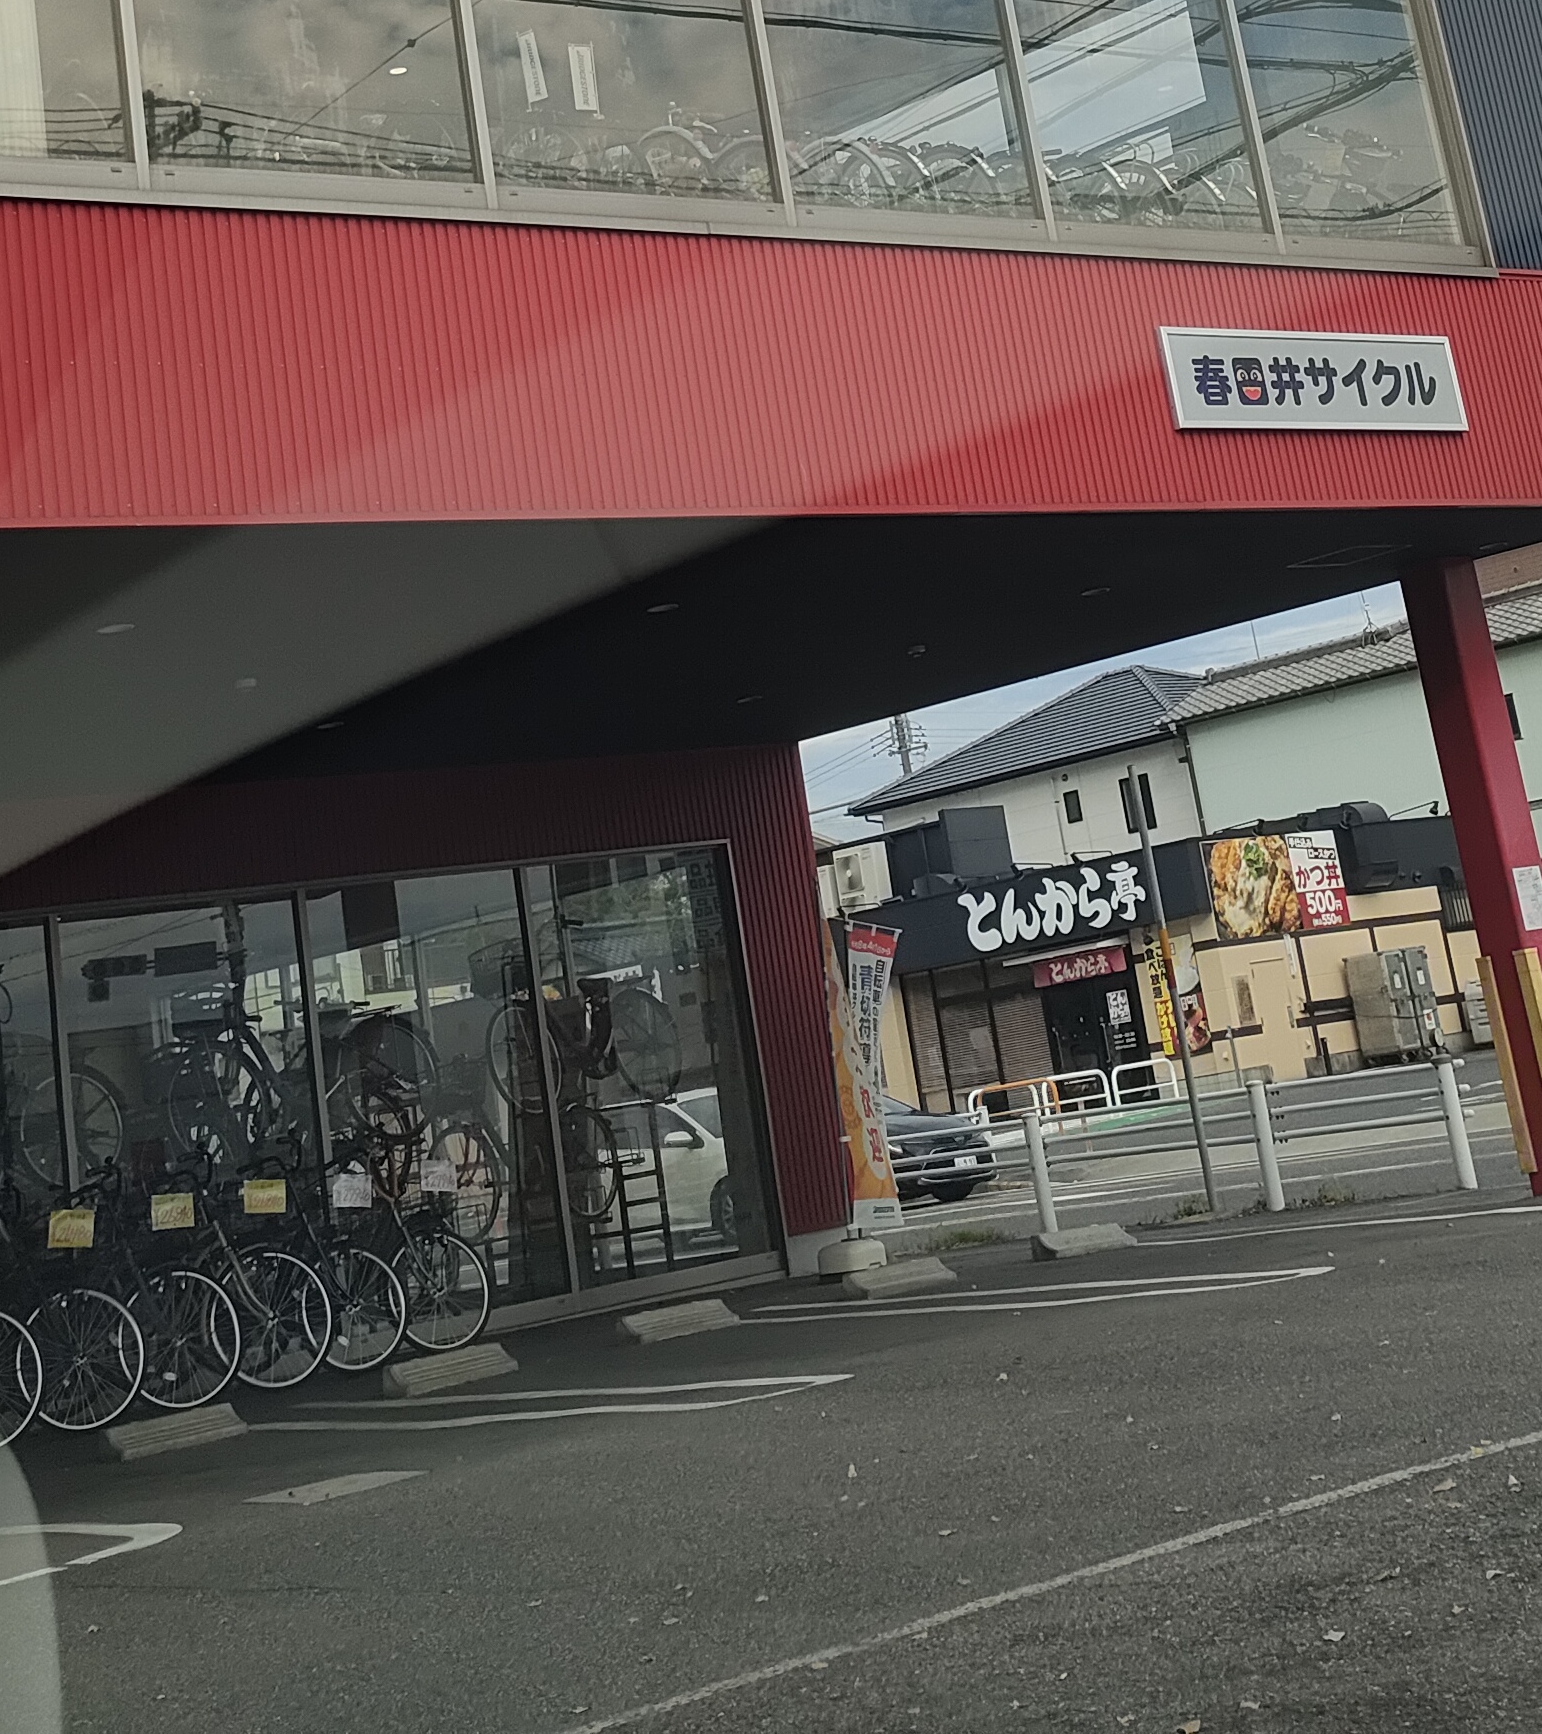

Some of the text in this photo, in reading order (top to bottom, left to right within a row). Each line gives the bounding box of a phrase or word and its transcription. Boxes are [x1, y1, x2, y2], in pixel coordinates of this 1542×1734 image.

[1295, 861, 1340, 889] かつ丼
[958, 861, 1146, 952] とんから亭
[1305, 890, 1343, 915] 500円
[1049, 954, 1109, 983] とんから亭
